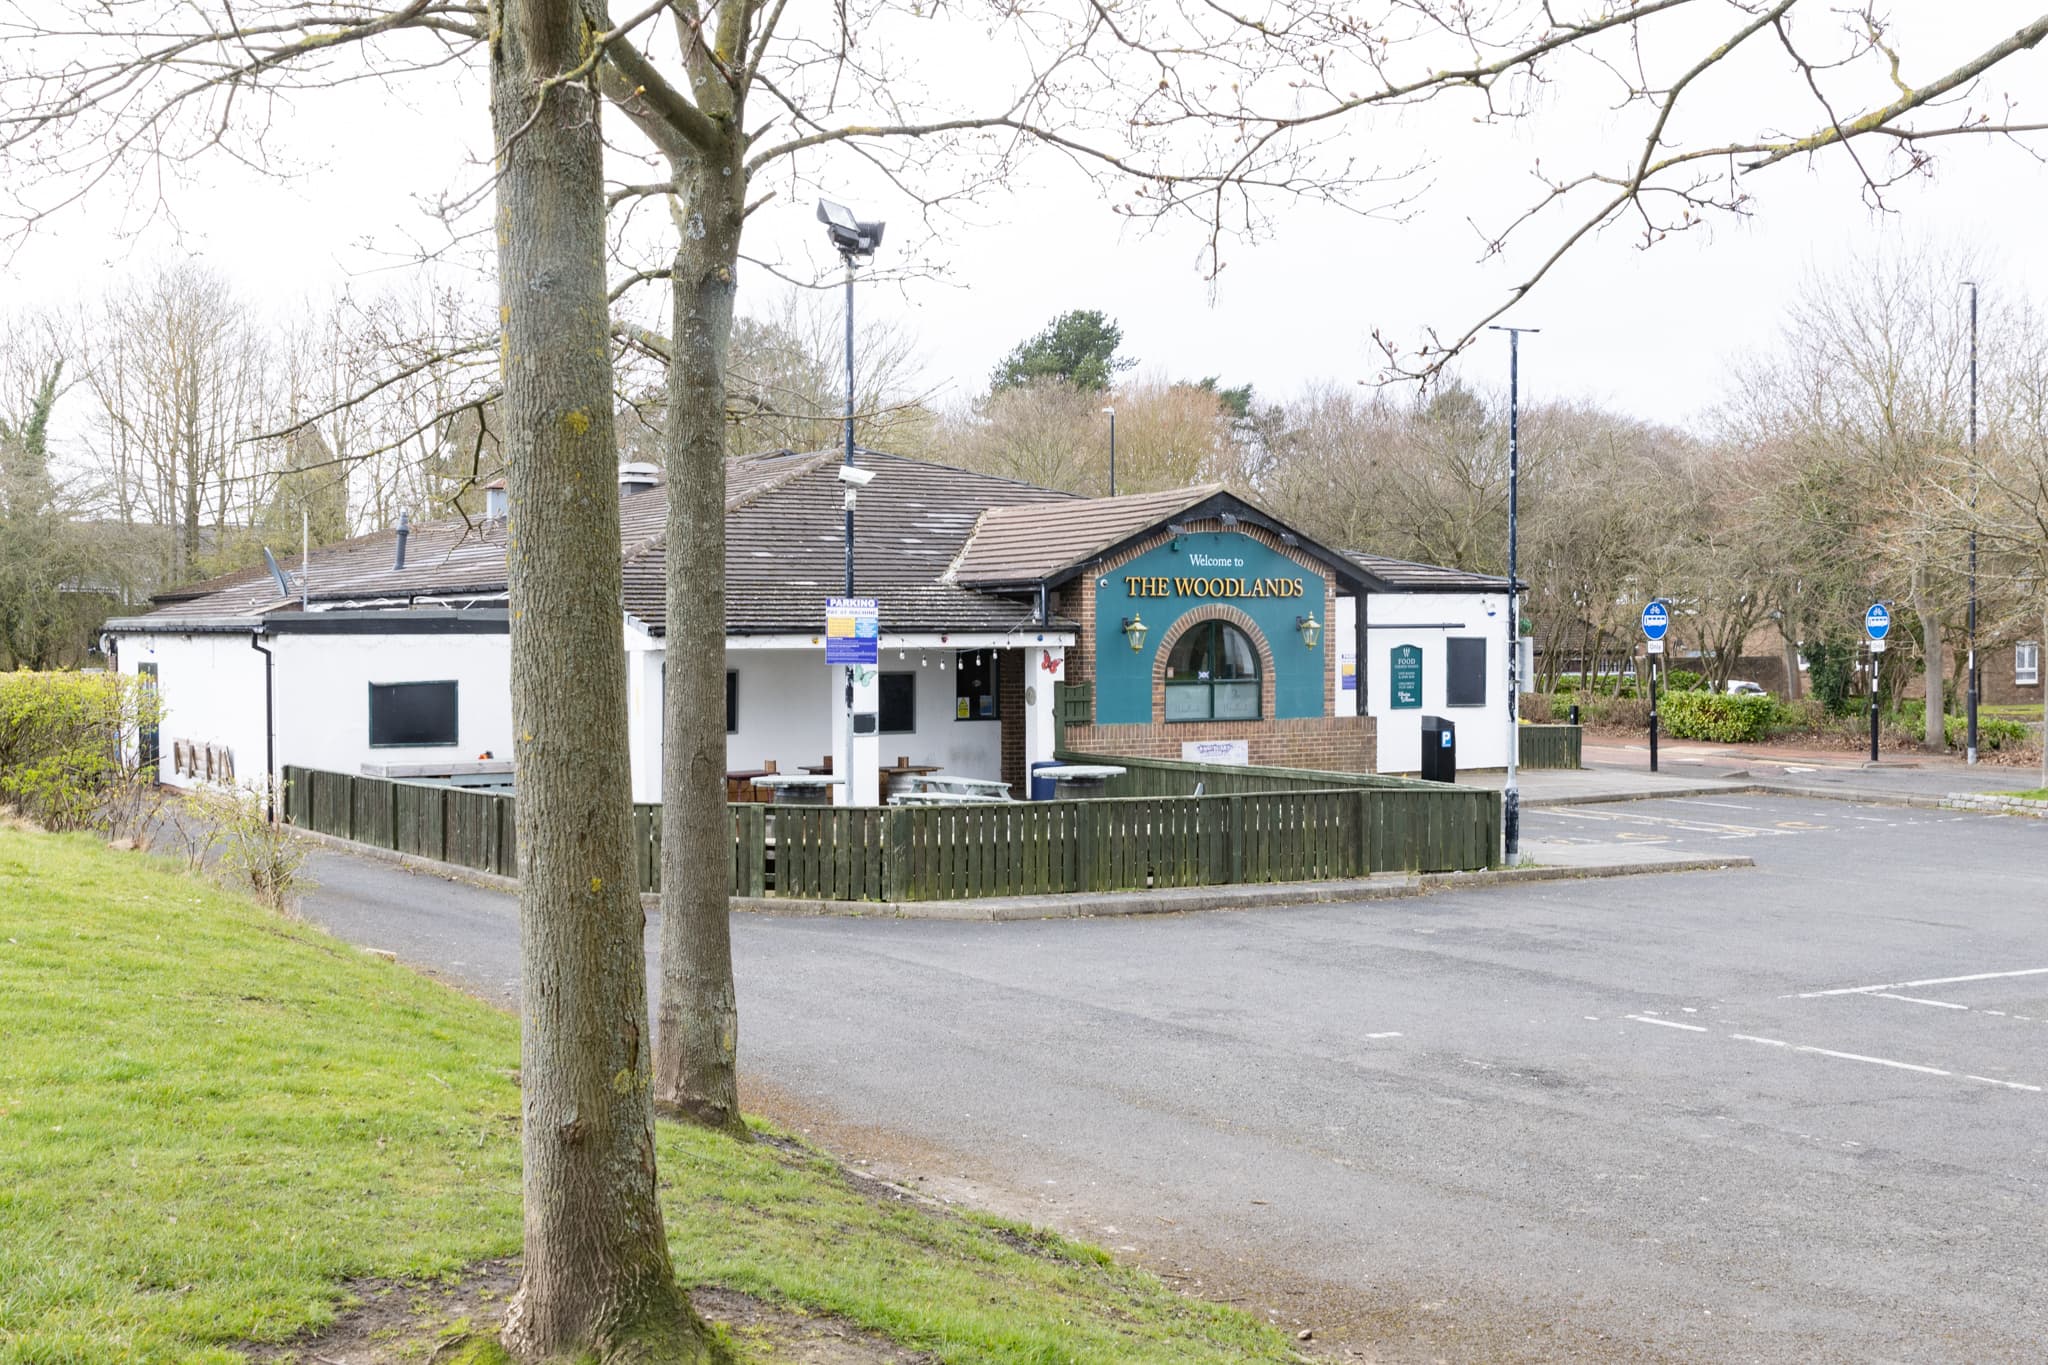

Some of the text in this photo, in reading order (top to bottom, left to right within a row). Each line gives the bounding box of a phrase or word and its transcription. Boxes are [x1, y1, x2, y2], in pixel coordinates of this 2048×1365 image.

[1189, 553, 1244, 567] Welcome to
[1125, 576, 1304, 598] THE WOODLANDS
[1442, 731, 1451, 745] P
